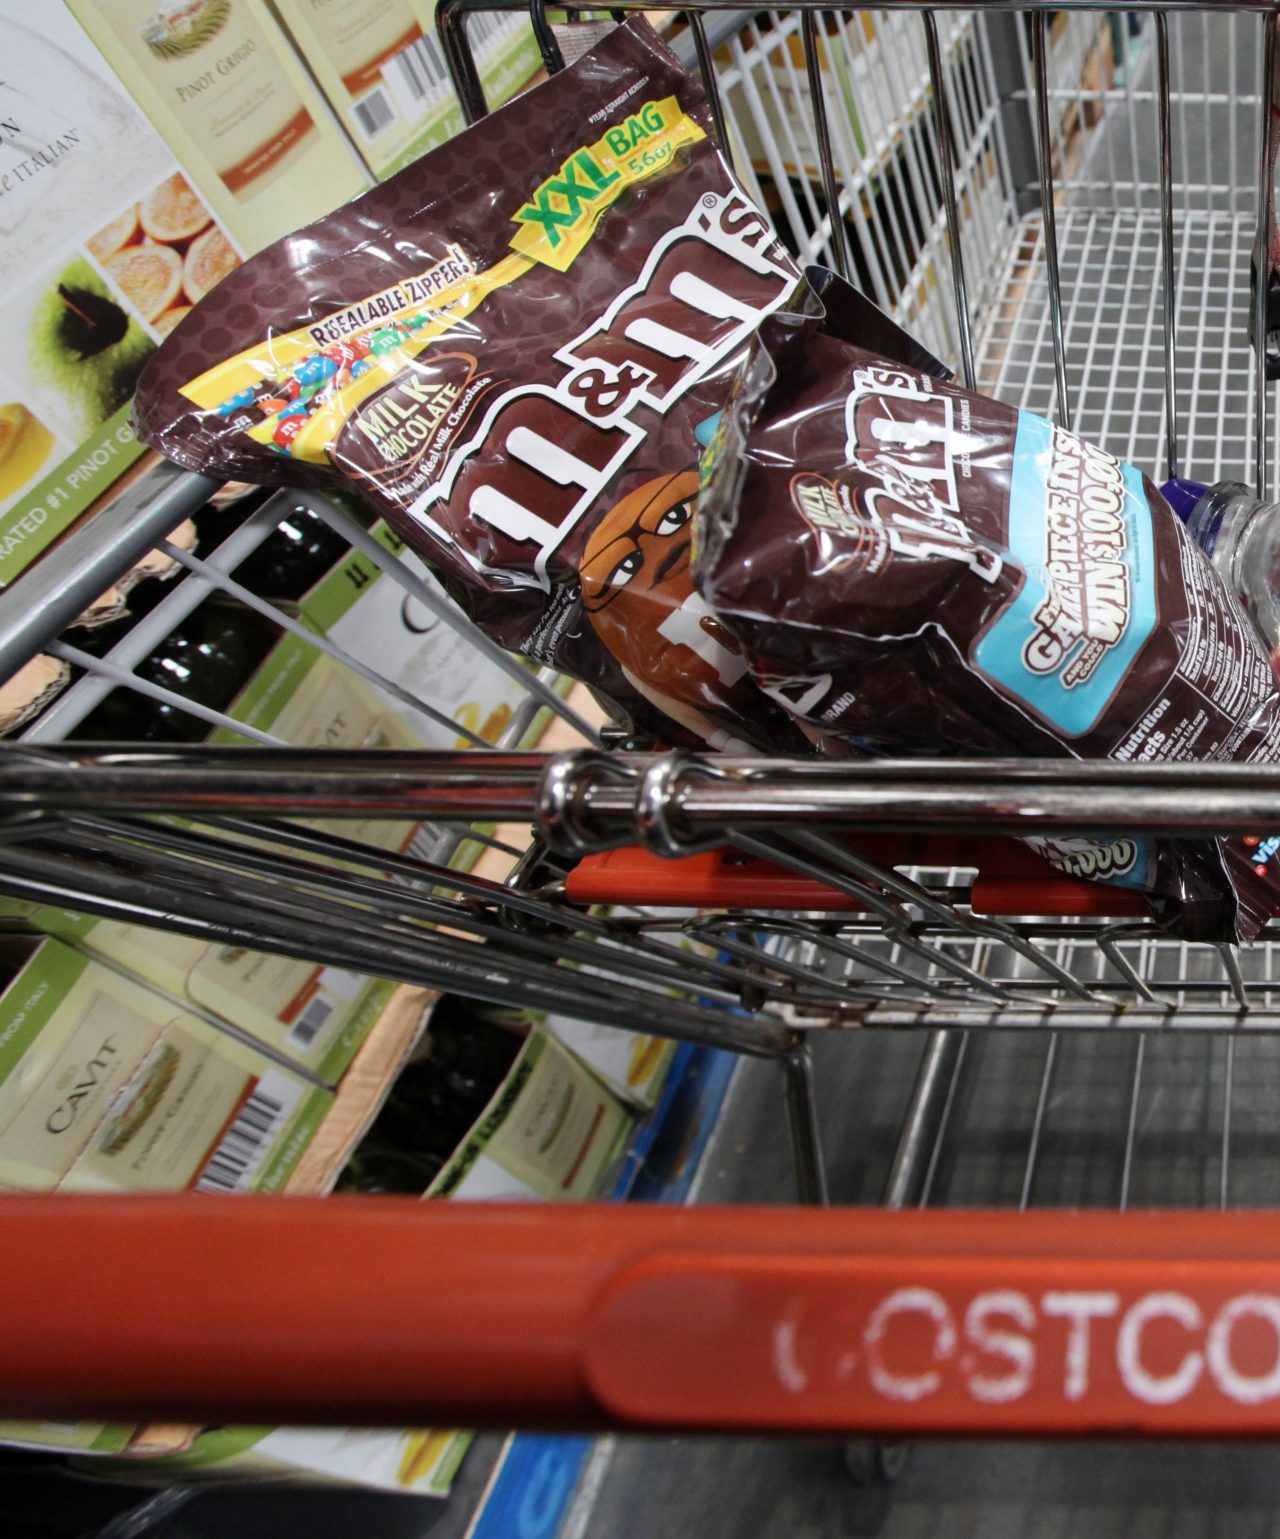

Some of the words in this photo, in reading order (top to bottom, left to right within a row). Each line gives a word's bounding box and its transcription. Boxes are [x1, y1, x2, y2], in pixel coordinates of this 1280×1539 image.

[176, 71, 216, 103] PINOT
[215, 39, 257, 76] GRIGIO
[604, 102, 665, 157] BAG
[628, 142, 675, 174] 56oz
[517, 146, 622, 248] XXL
[356, 374, 444, 442] MILK
[379, 383, 460, 463] CHOCOLATE
[437, 425, 453, 452] Milk
[447, 375, 491, 426] Chocolate
[46, 487, 70, 509] #1
[67, 443, 118, 490] PINOT
[1046, 493, 1079, 582] PIECE
[1084, 560, 1126, 642] WIN
[1079, 643, 1104, 676] COULD
[1212, 660, 1233, 701] Cholesterol
[820, 690, 857, 722] BRAND
[1115, 698, 1171, 762] Nutrition
[1185, 717, 1210, 748] Container
[1231, 692, 1247, 717] Vitamin
[1137, 729, 1165, 762] acts
[46, 1032, 119, 1135] CAVIT
